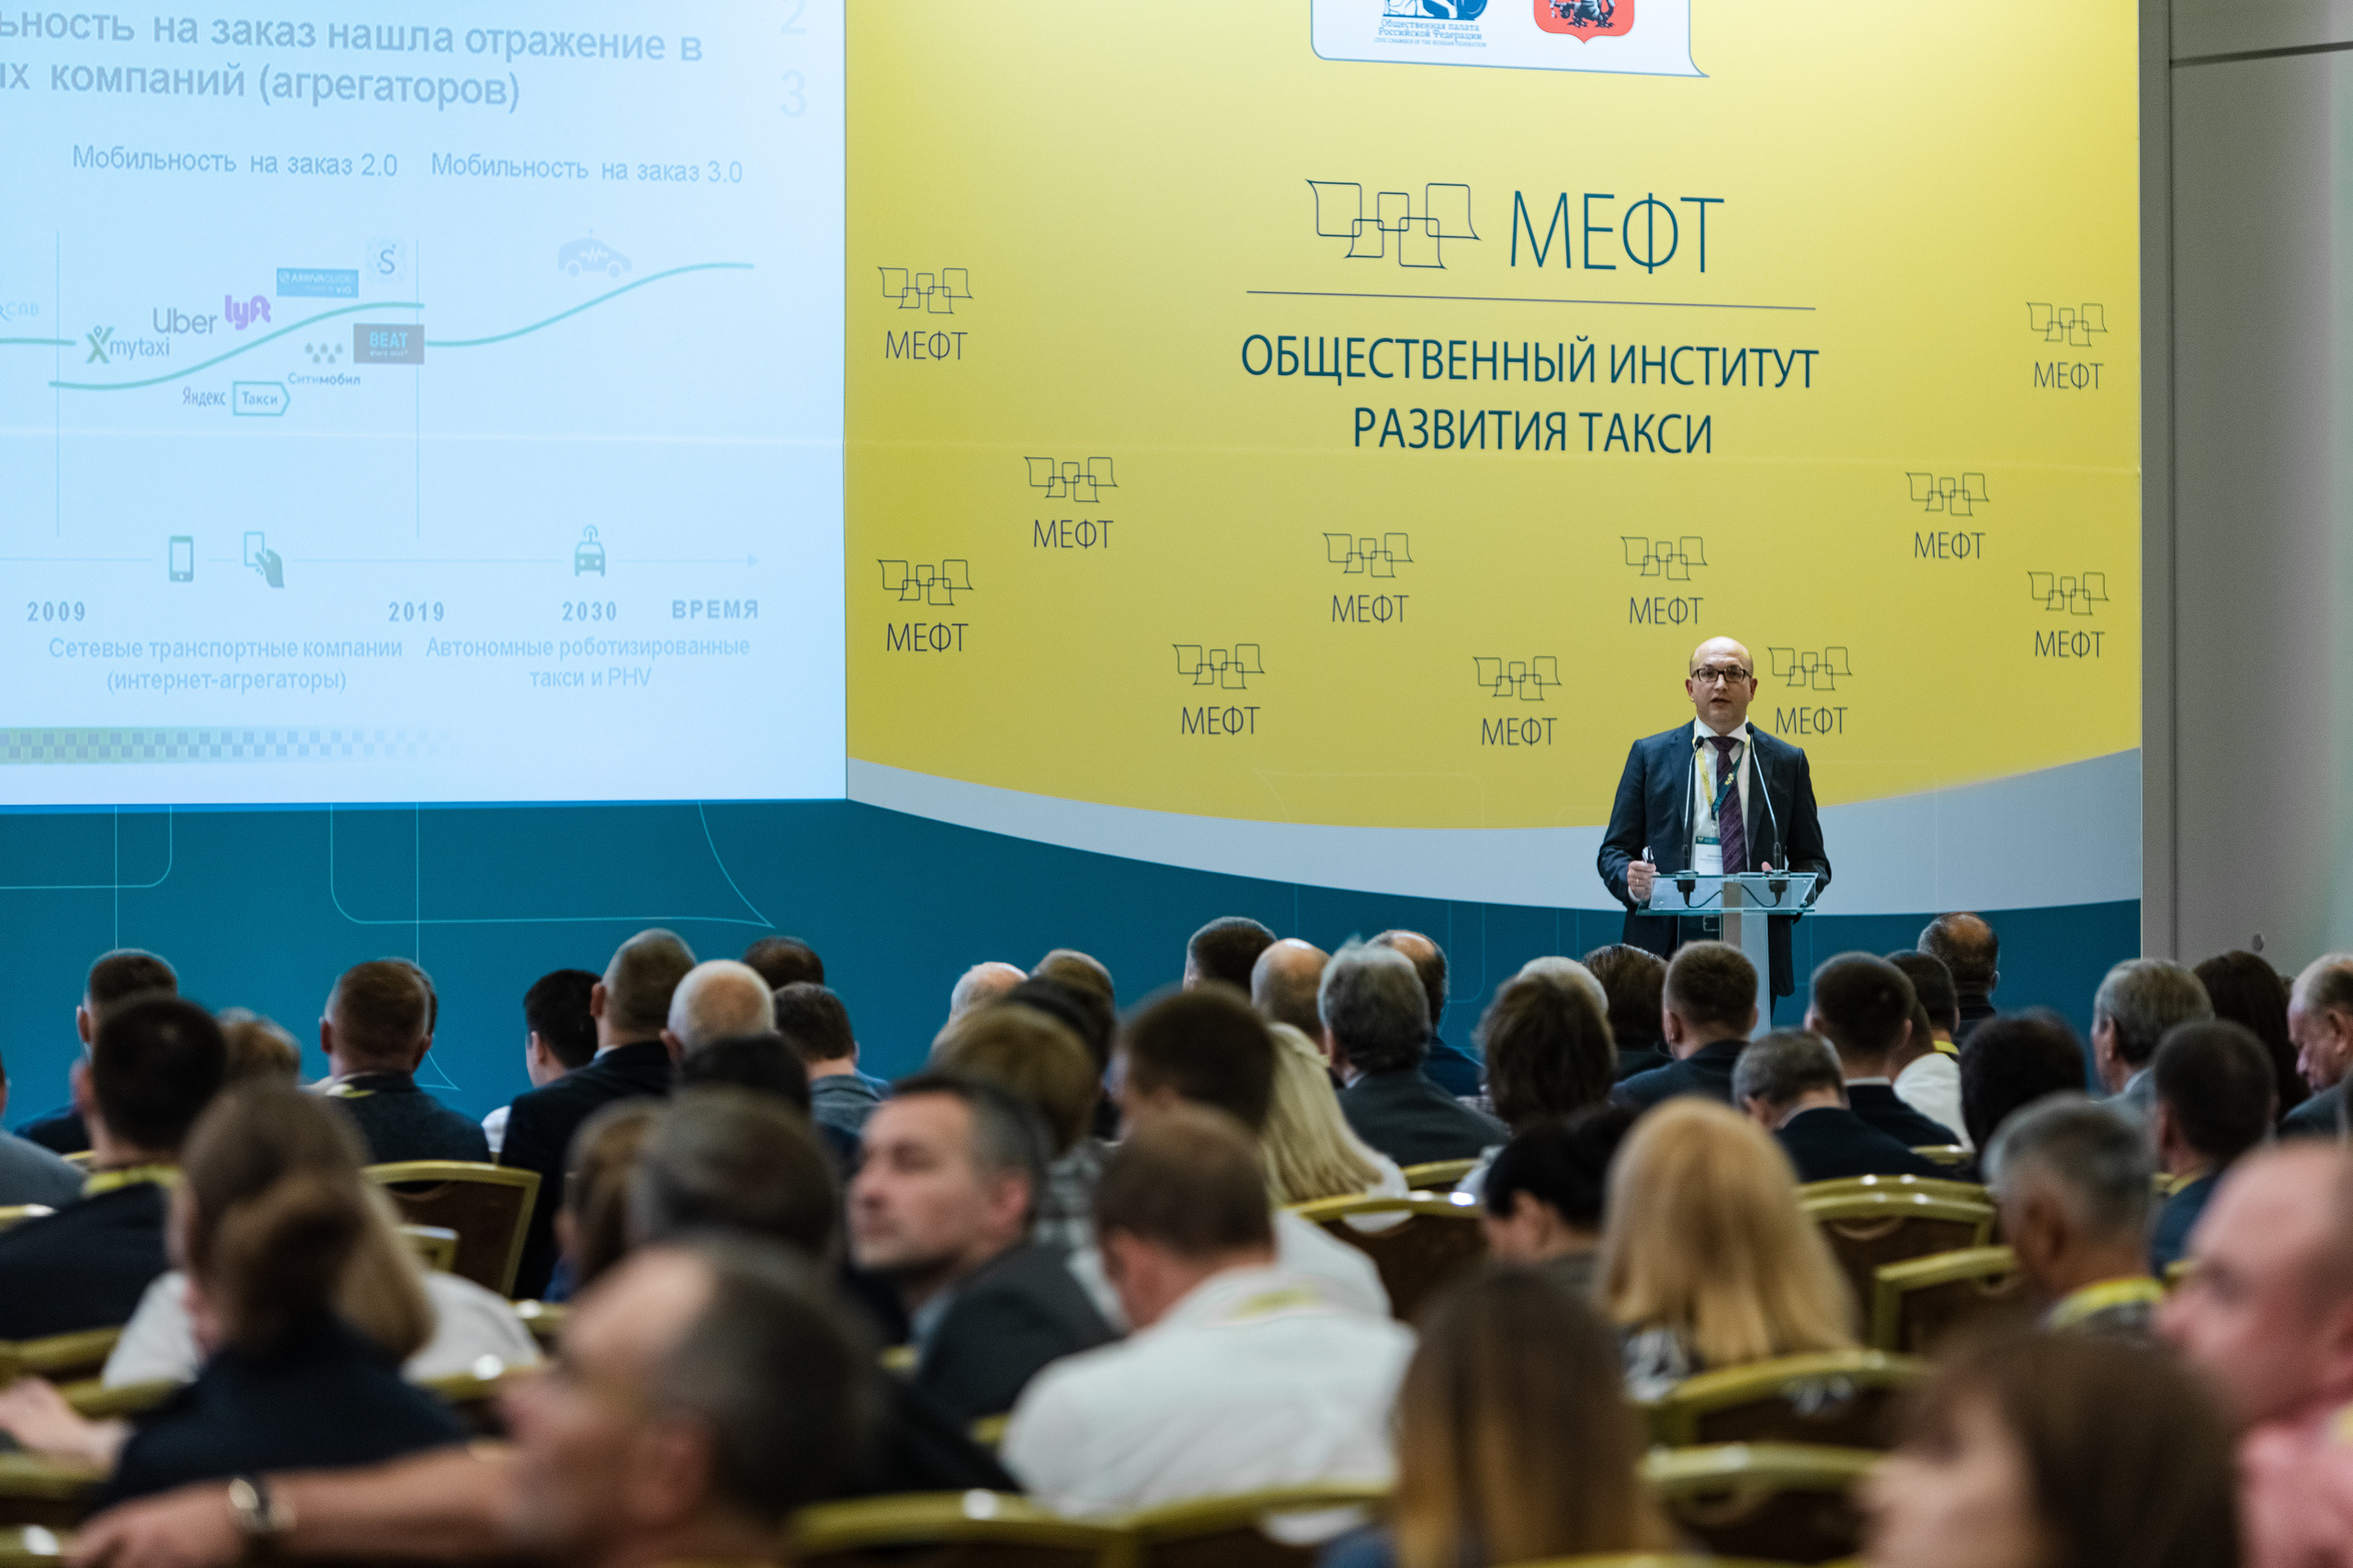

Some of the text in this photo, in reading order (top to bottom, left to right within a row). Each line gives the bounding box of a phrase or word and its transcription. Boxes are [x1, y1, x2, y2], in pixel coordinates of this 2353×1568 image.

[154, 17, 198, 43] на
[211, 19, 315, 47] заказ
[329, 23, 453, 52] нашла
[465, 28, 665, 62] отражение
[681, 37, 702, 61] в
[51, 62, 244, 96] компаний
[260, 63, 518, 112] (агрегаторов)
[74, 144, 397, 176] Мобильность на заказ 2.0
[432, 153, 742, 183] Мобильность на заказ 3.0
[1511, 191, 1724, 274] МЕФТ
[153, 308, 217, 334] Uber
[225, 295, 270, 330] lyft
[109, 337, 169, 360] mytaxi
[370, 332, 408, 347] BEAT
[886, 331, 967, 360] МЕФТ
[1242, 335, 1819, 388] ОБЩЕСТВЕННЫЙ ИНСТИТУТ
[288, 372, 360, 385] Ситимобил
[2034, 362, 2104, 390] МЕФТ
[183, 387, 278, 406] Яндекс Такси
[1355, 407, 1711, 453] РАЗВИТИЯ ТАКСИ
[1034, 519, 1113, 549] МЕФТ
[1915, 532, 1985, 559] МЕФТ
[28, 601, 85, 621] 2009
[389, 602, 444, 621] 2019
[563, 601, 616, 620] 2030
[673, 600, 757, 619] ВРЕМЯ
[1332, 595, 1409, 623] МЕФТ
[1630, 597, 1703, 625] МЕФТ
[426, 637, 750, 662] Автономные роботизированные
[887, 622, 969, 652] МЕФТ
[2035, 631, 2105, 658] МЕФТ
[50, 638, 402, 664] Сетевые транспортные компании
[108, 671, 346, 694] (интернет-агрегаторы)
[530, 667, 652, 687] такси и PHV
[1182, 706, 1260, 735] МЕФТ
[1482, 718, 1557, 745] МЕФТ
[1776, 707, 1847, 734] МЕФТ
